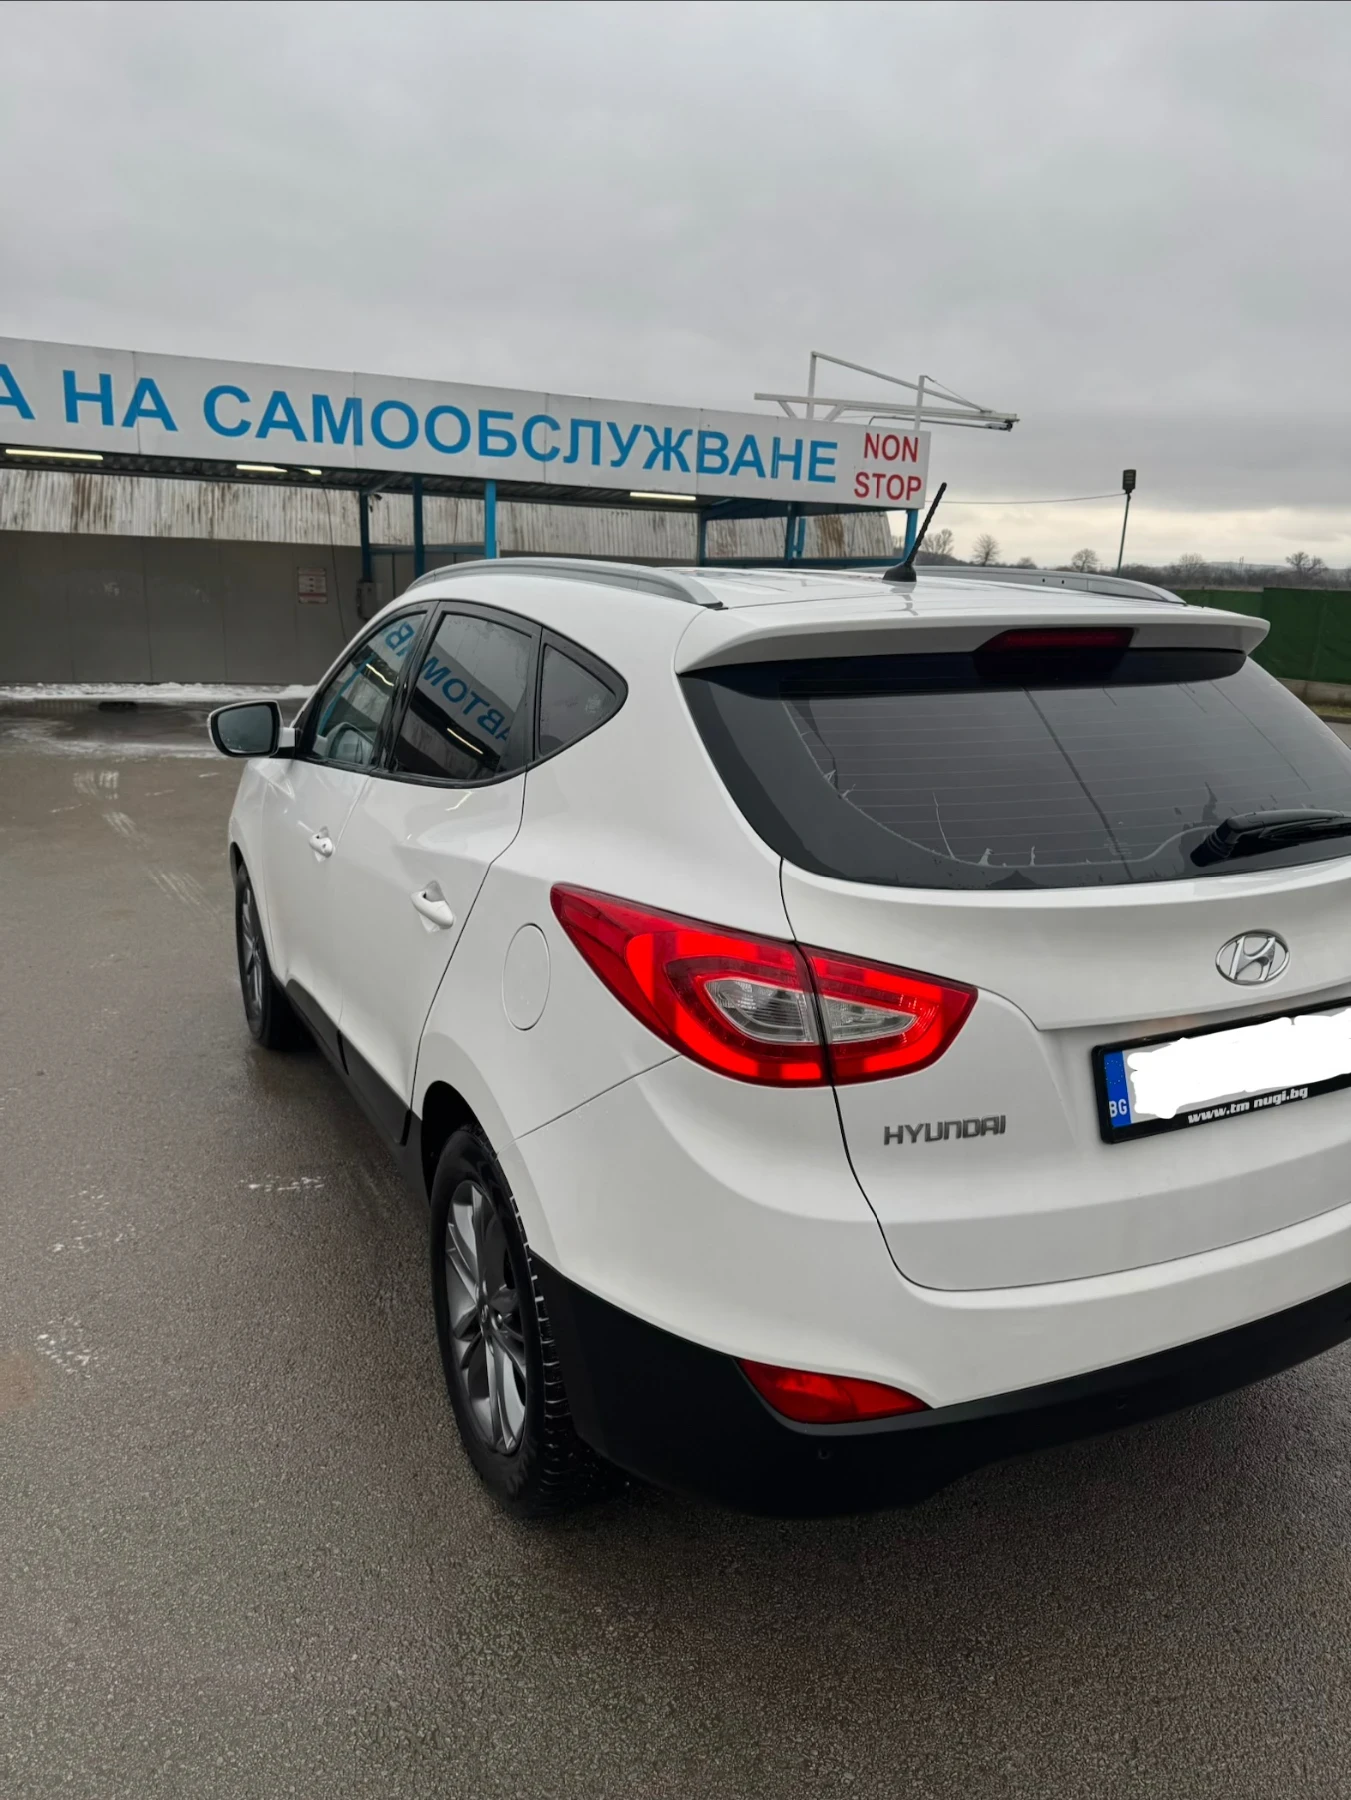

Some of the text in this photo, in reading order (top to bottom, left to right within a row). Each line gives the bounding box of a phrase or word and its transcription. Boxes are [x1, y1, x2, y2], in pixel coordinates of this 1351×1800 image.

[63, 369, 178, 432] НА
[203, 385, 838, 484] САМООБСЛУЖВАНЕ
[864, 432, 919, 463] NON
[854, 471, 922, 501] STOP
[1108, 1098, 1128, 1118] BG
[883, 1114, 1006, 1146] HYUNDAI
